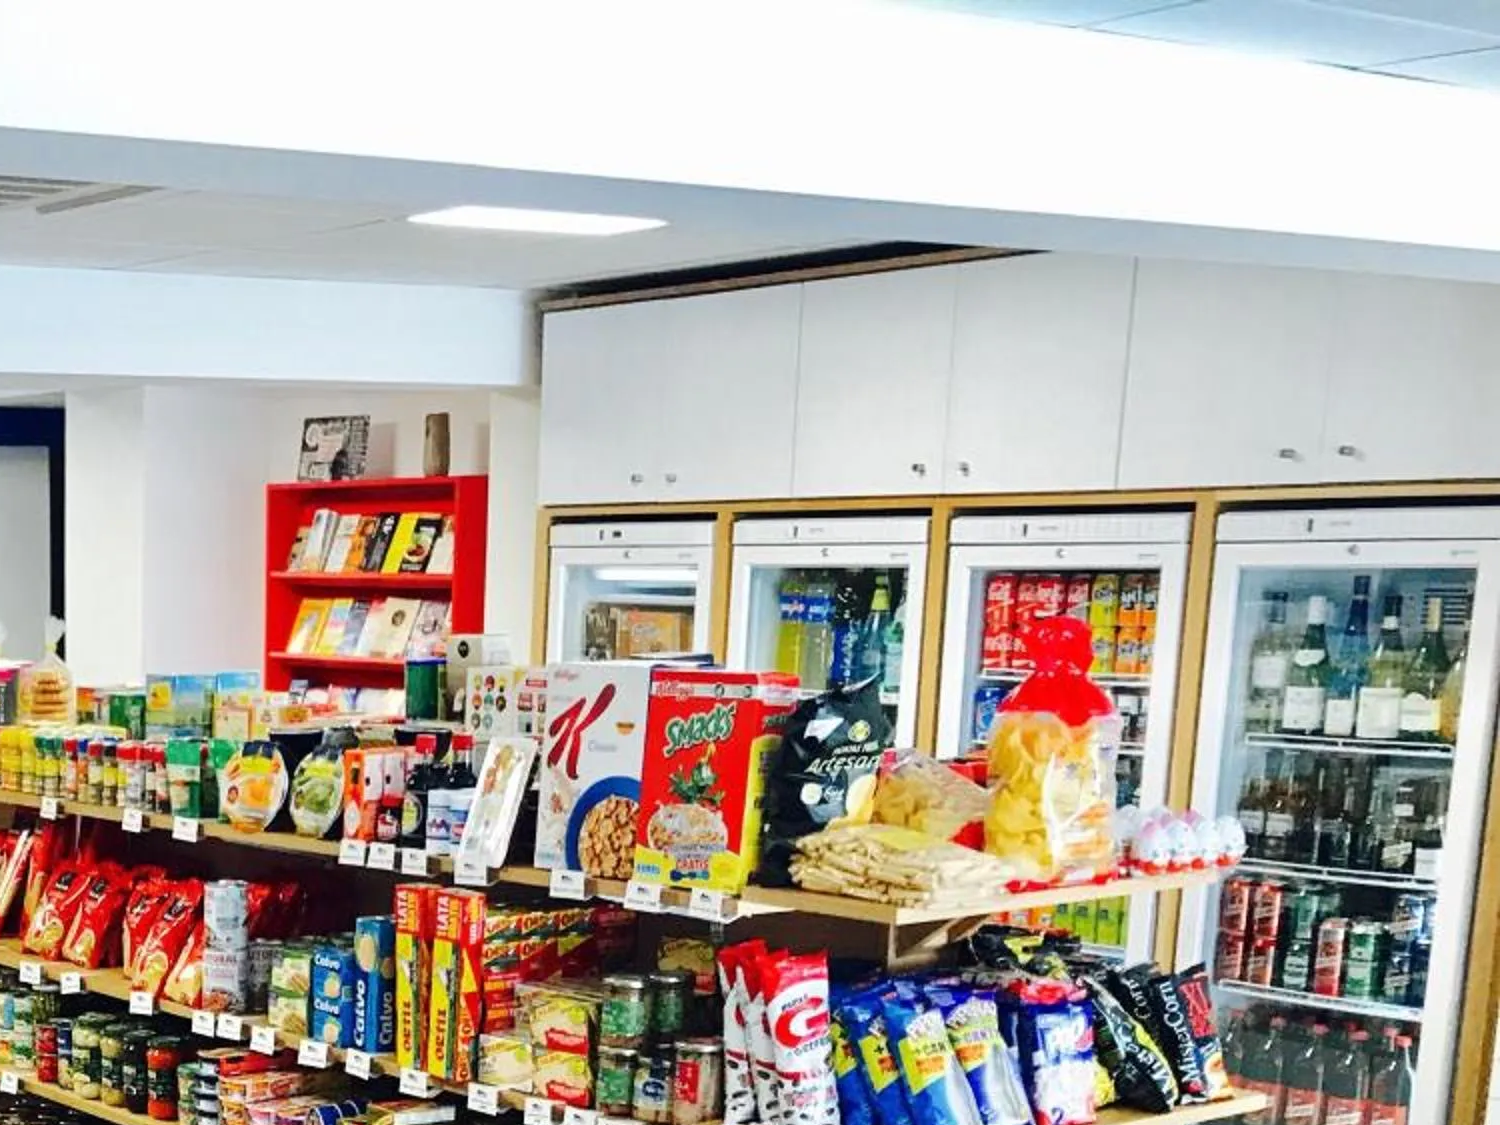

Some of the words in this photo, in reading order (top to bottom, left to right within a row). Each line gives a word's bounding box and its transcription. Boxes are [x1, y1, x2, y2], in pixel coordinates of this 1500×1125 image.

[353, 979, 366, 1047] Calvo
[379, 991, 393, 1045] Calvo
[1159, 980, 1201, 1083] MisterCorn
